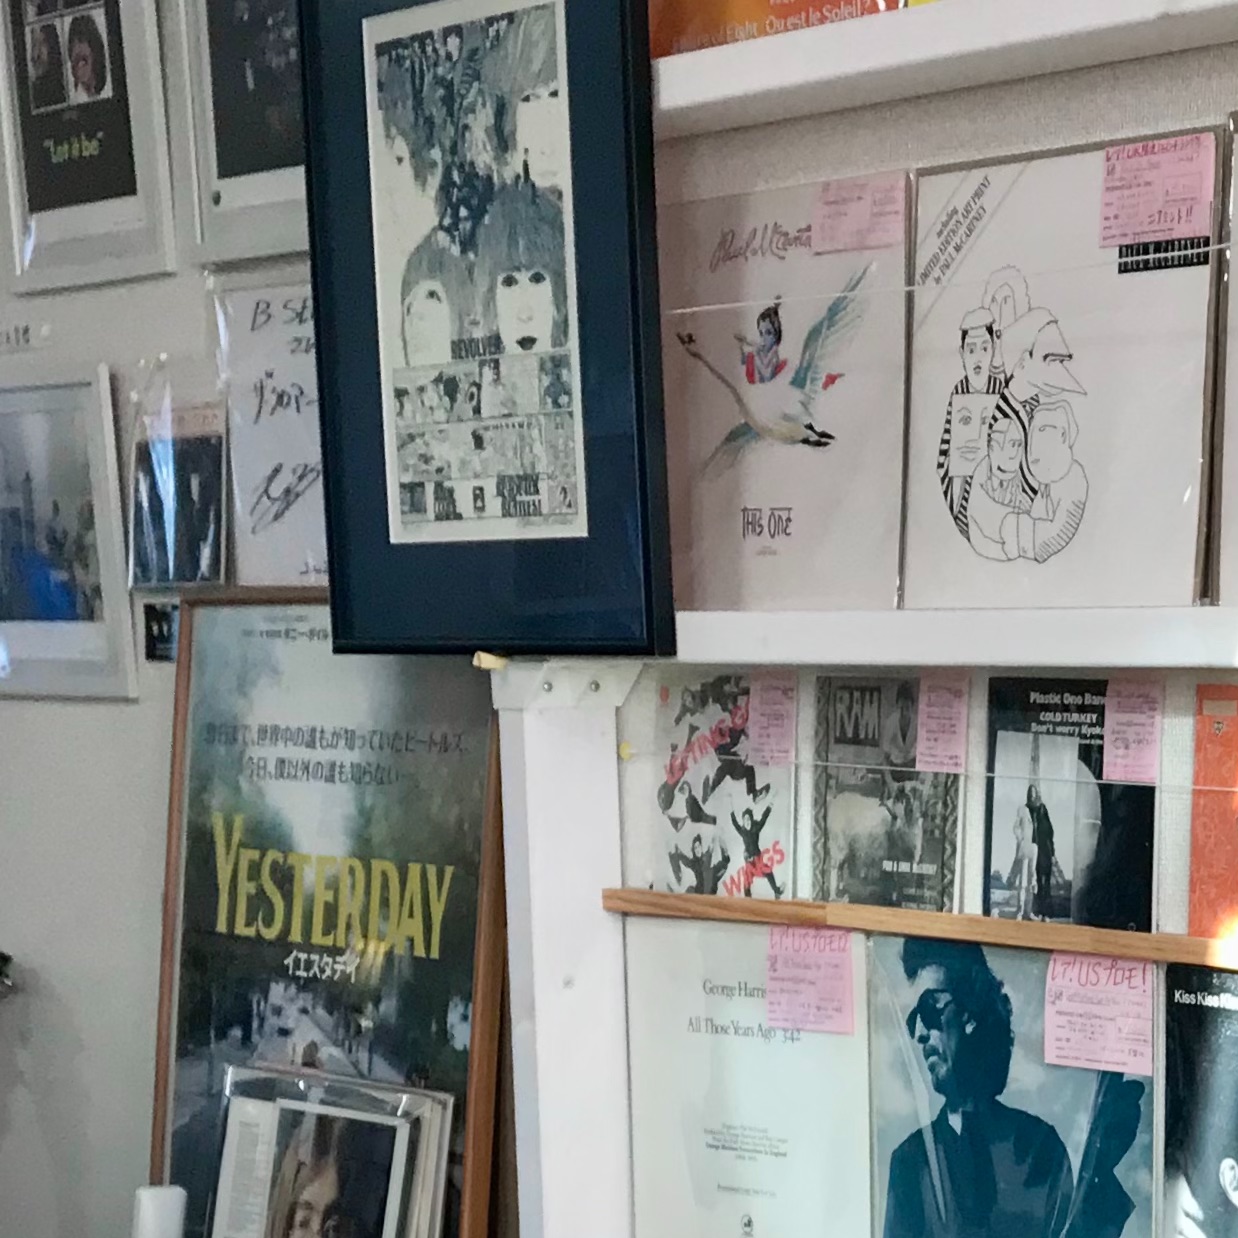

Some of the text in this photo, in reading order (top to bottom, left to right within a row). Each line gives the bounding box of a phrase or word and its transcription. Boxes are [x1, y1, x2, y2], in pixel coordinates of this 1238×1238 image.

[1063, 692, 1083, 705] Ono
[1084, 693, 1105, 705] Ban
[835, 687, 880, 741] RAM
[1040, 711, 1098, 723] COLD TURKEY
[722, 840, 786, 897] WINGS
[210, 811, 455, 960] YESTERDAY
[283, 949, 360, 983] イエスタデイ
[702, 978, 767, 1000] George Harris
[1174, 989, 1196, 1006] Kiss
[1197, 991, 1220, 1008] Kiss
[687, 1016, 777, 1044] All Those Years Ago
